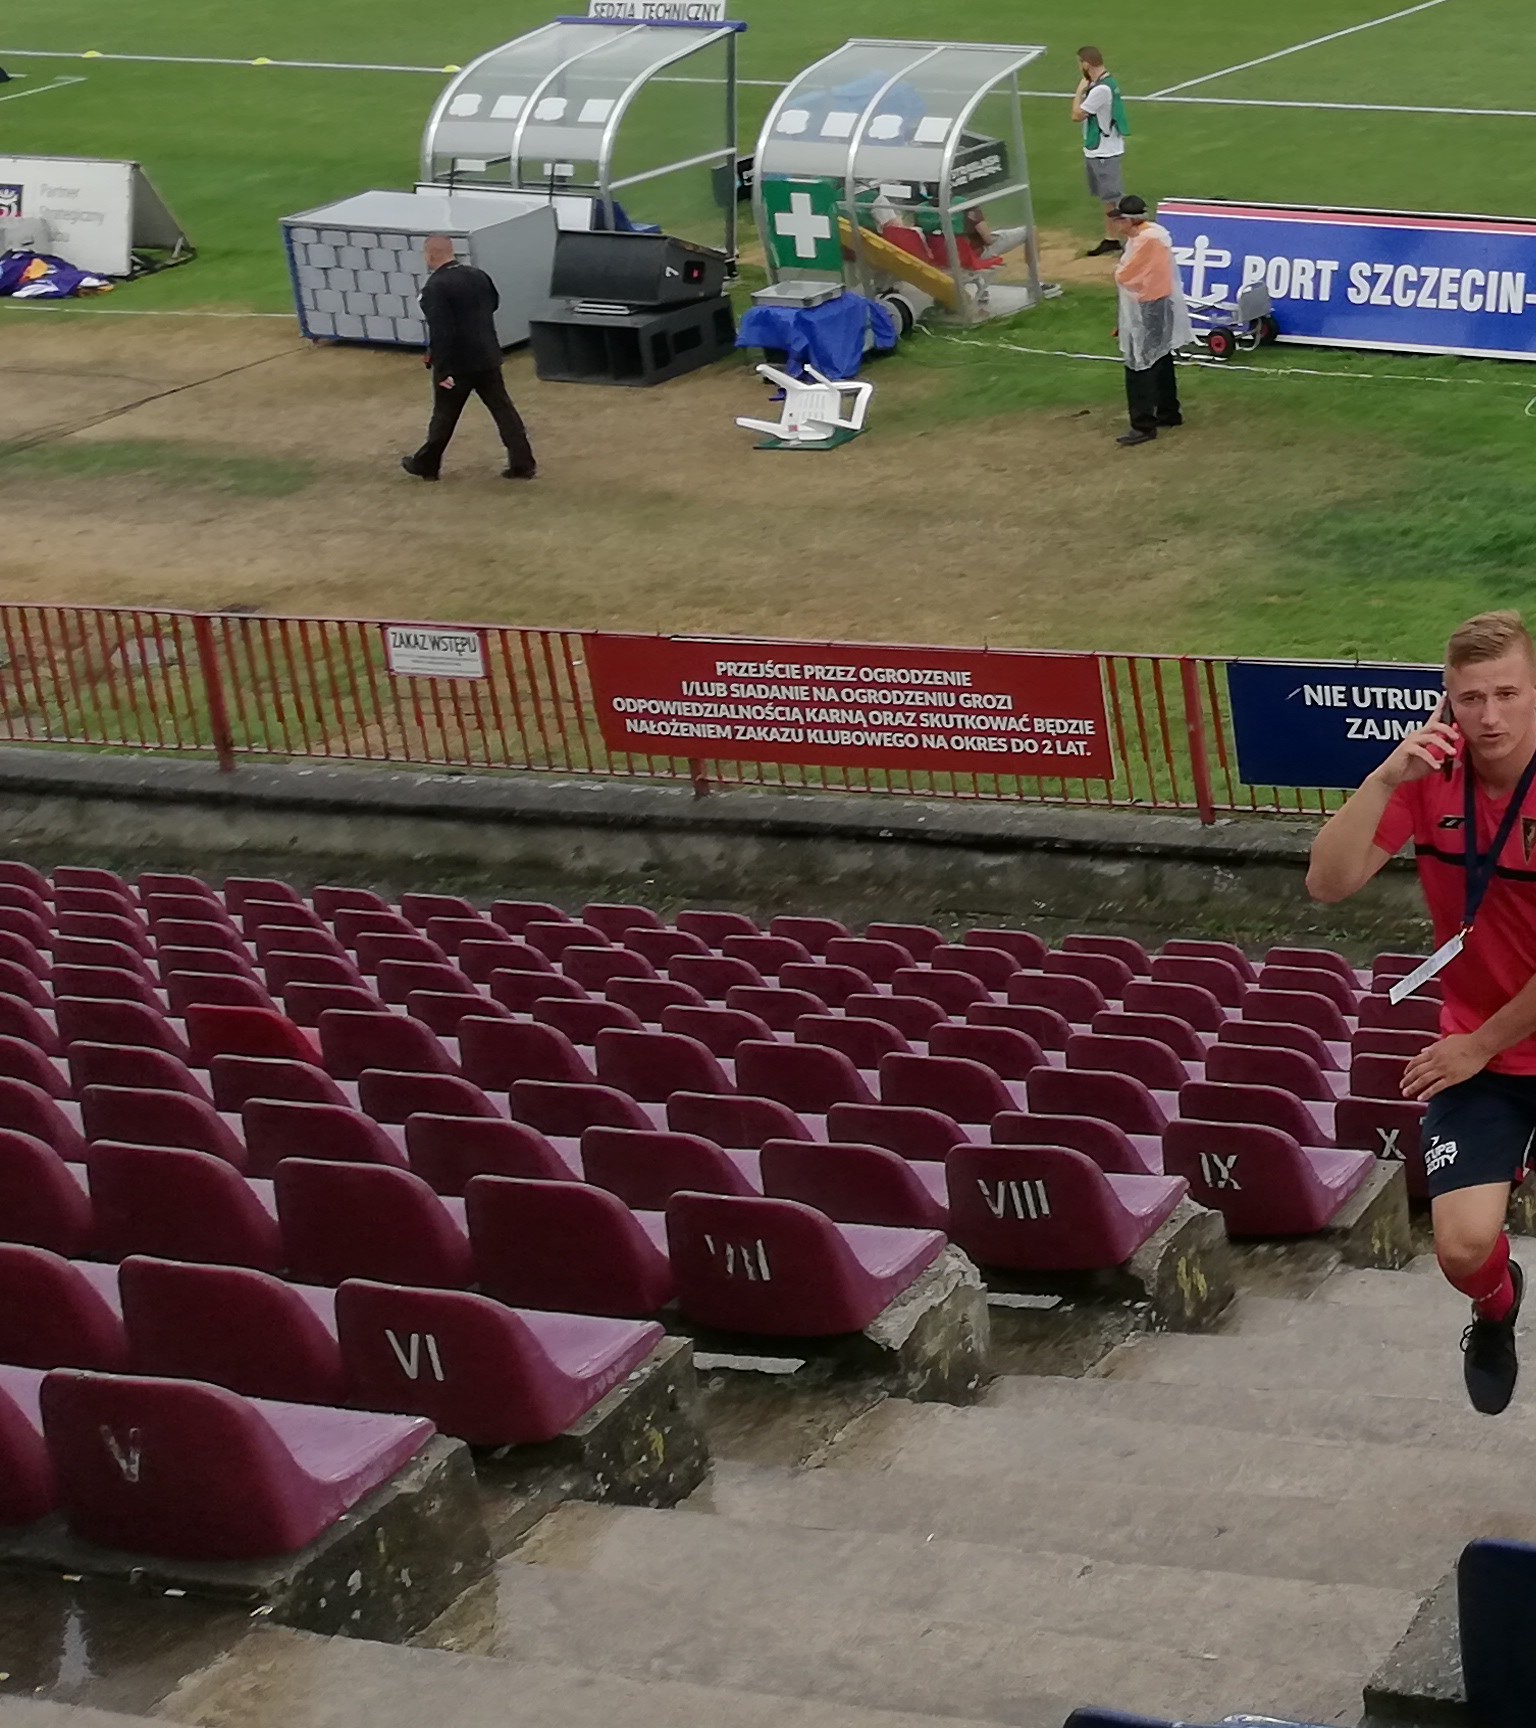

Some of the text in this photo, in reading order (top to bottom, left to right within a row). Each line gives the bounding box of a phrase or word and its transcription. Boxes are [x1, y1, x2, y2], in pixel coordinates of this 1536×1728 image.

[1243, 254, 1339, 302] PORT
[392, 631, 477, 657] ZAKAZ WSTĘPU
[715, 660, 973, 687] PRZEJŚCIE PRZEZ OGRODZENIE
[682, 680, 1013, 710] I/LUB SIADANIE NA OGRODZENIU GROZI
[1303, 684, 1348, 707] NIE
[612, 696, 1096, 737] ODPOWIEDZIALNOŚCIĄ KARNĄ ORAZ SKUTKOWAĆ BĘDZIE
[625, 718, 1092, 756] NAŁOŻENIEM ZAKAZU KLUBOWEGO NA OKRES DO 2 LAT.
[1200, 1150, 1243, 1192] IX
[977, 1177, 1052, 1220] VIII
[384, 1328, 445, 1382] VI
[101, 1424, 142, 1483] V
